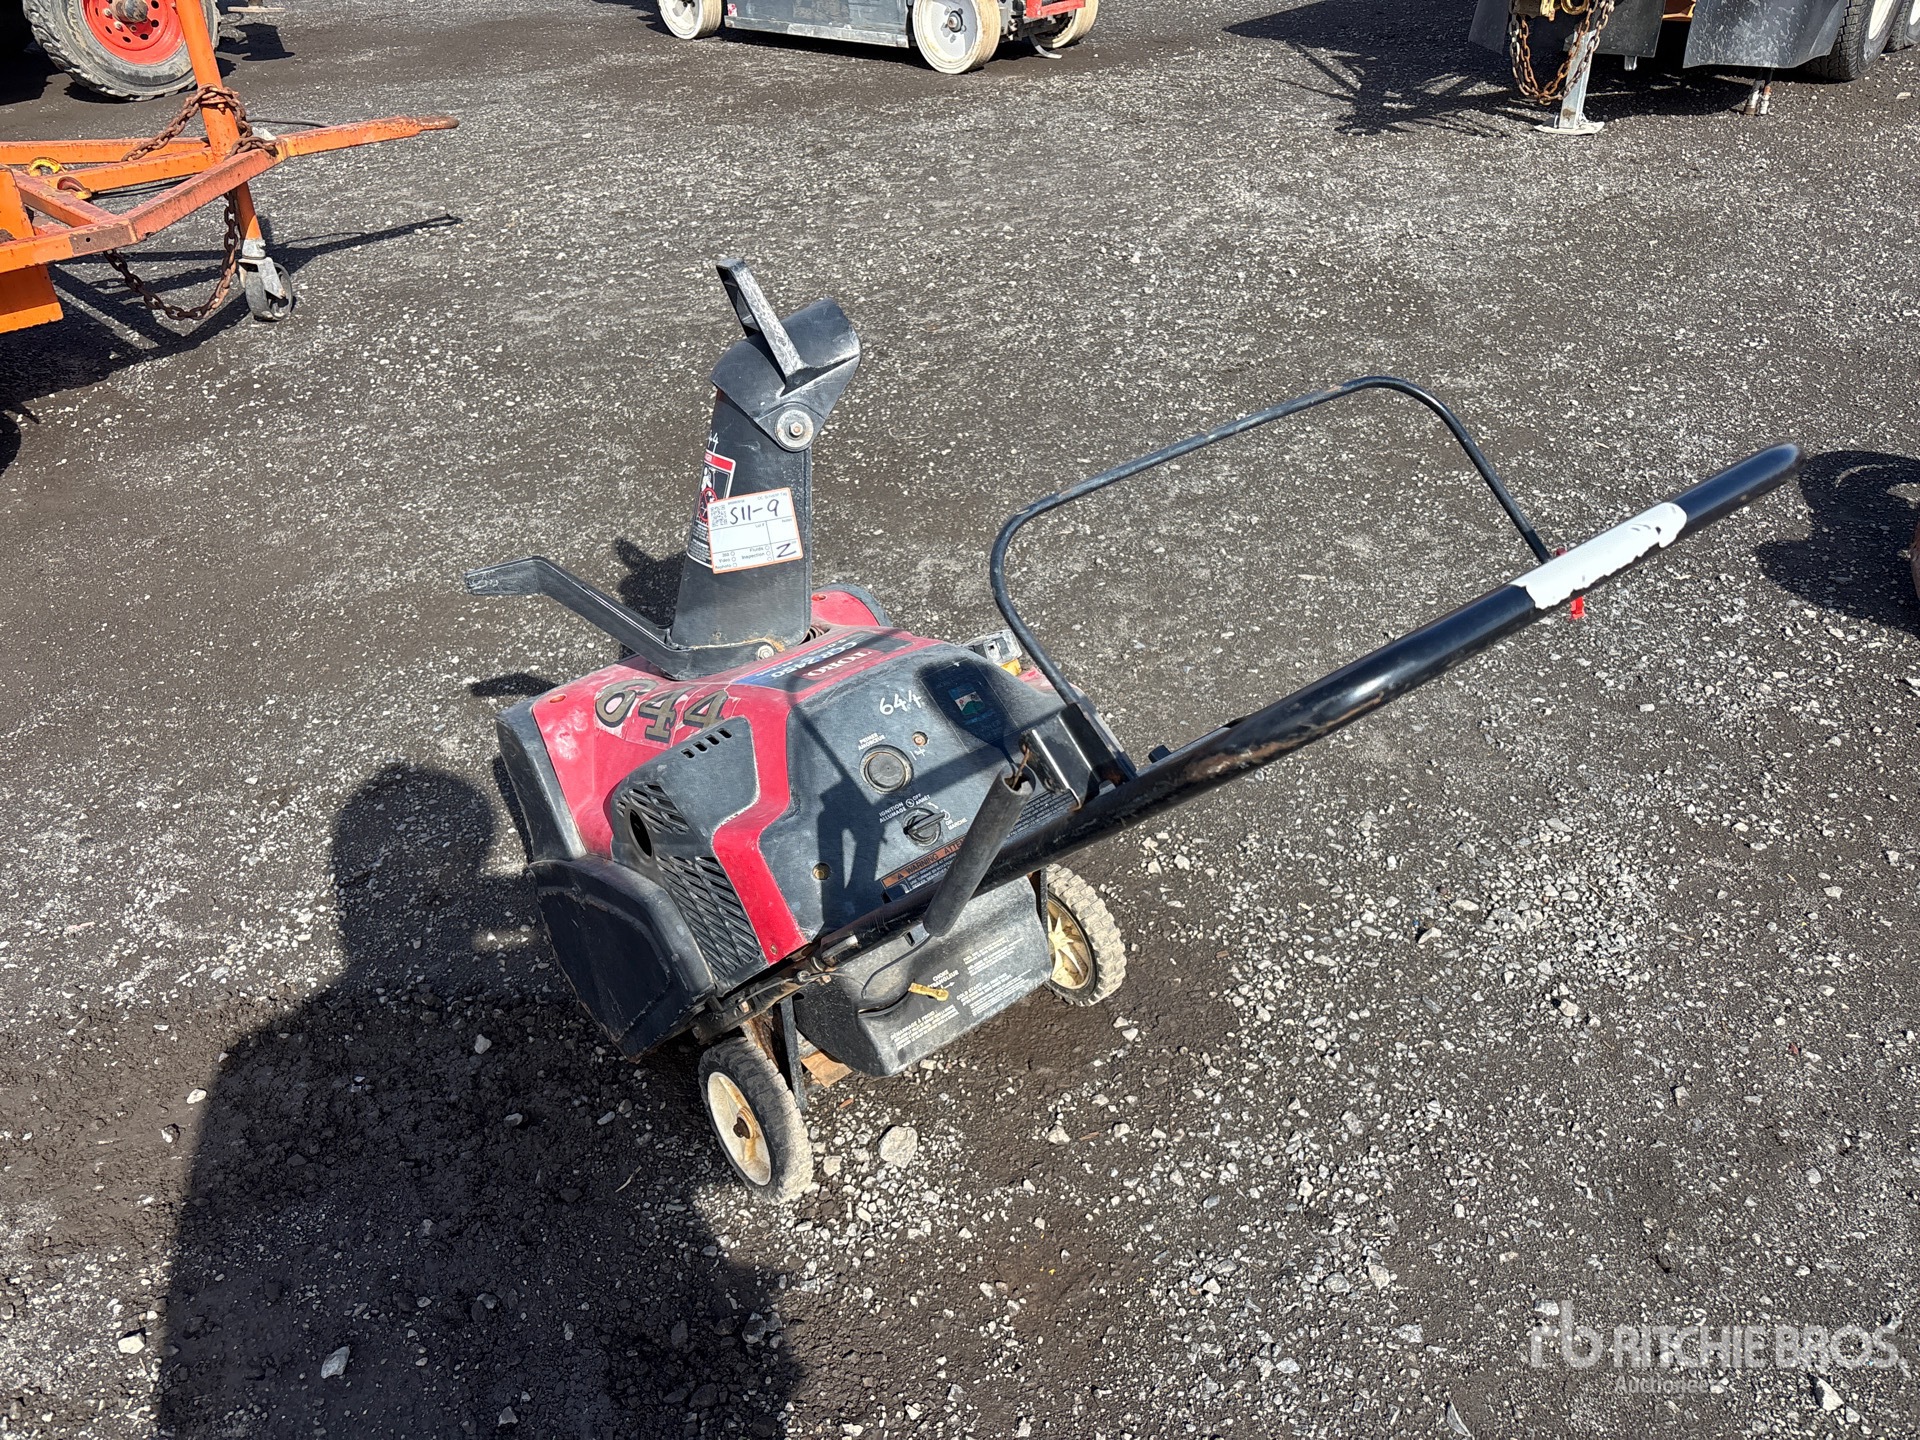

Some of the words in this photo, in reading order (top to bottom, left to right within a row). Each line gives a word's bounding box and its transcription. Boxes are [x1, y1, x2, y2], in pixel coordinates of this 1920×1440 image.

[741, 552, 765, 561] Inspection
[819, 641, 858, 660] CCR
[770, 656, 819, 678] 2450
[802, 650, 873, 677] TORO
[594, 679, 730, 743] 644
[879, 802, 904, 816] IGNITION
[879, 808, 907, 823] ALLUMAGE
[905, 853, 939, 875] WARNING
